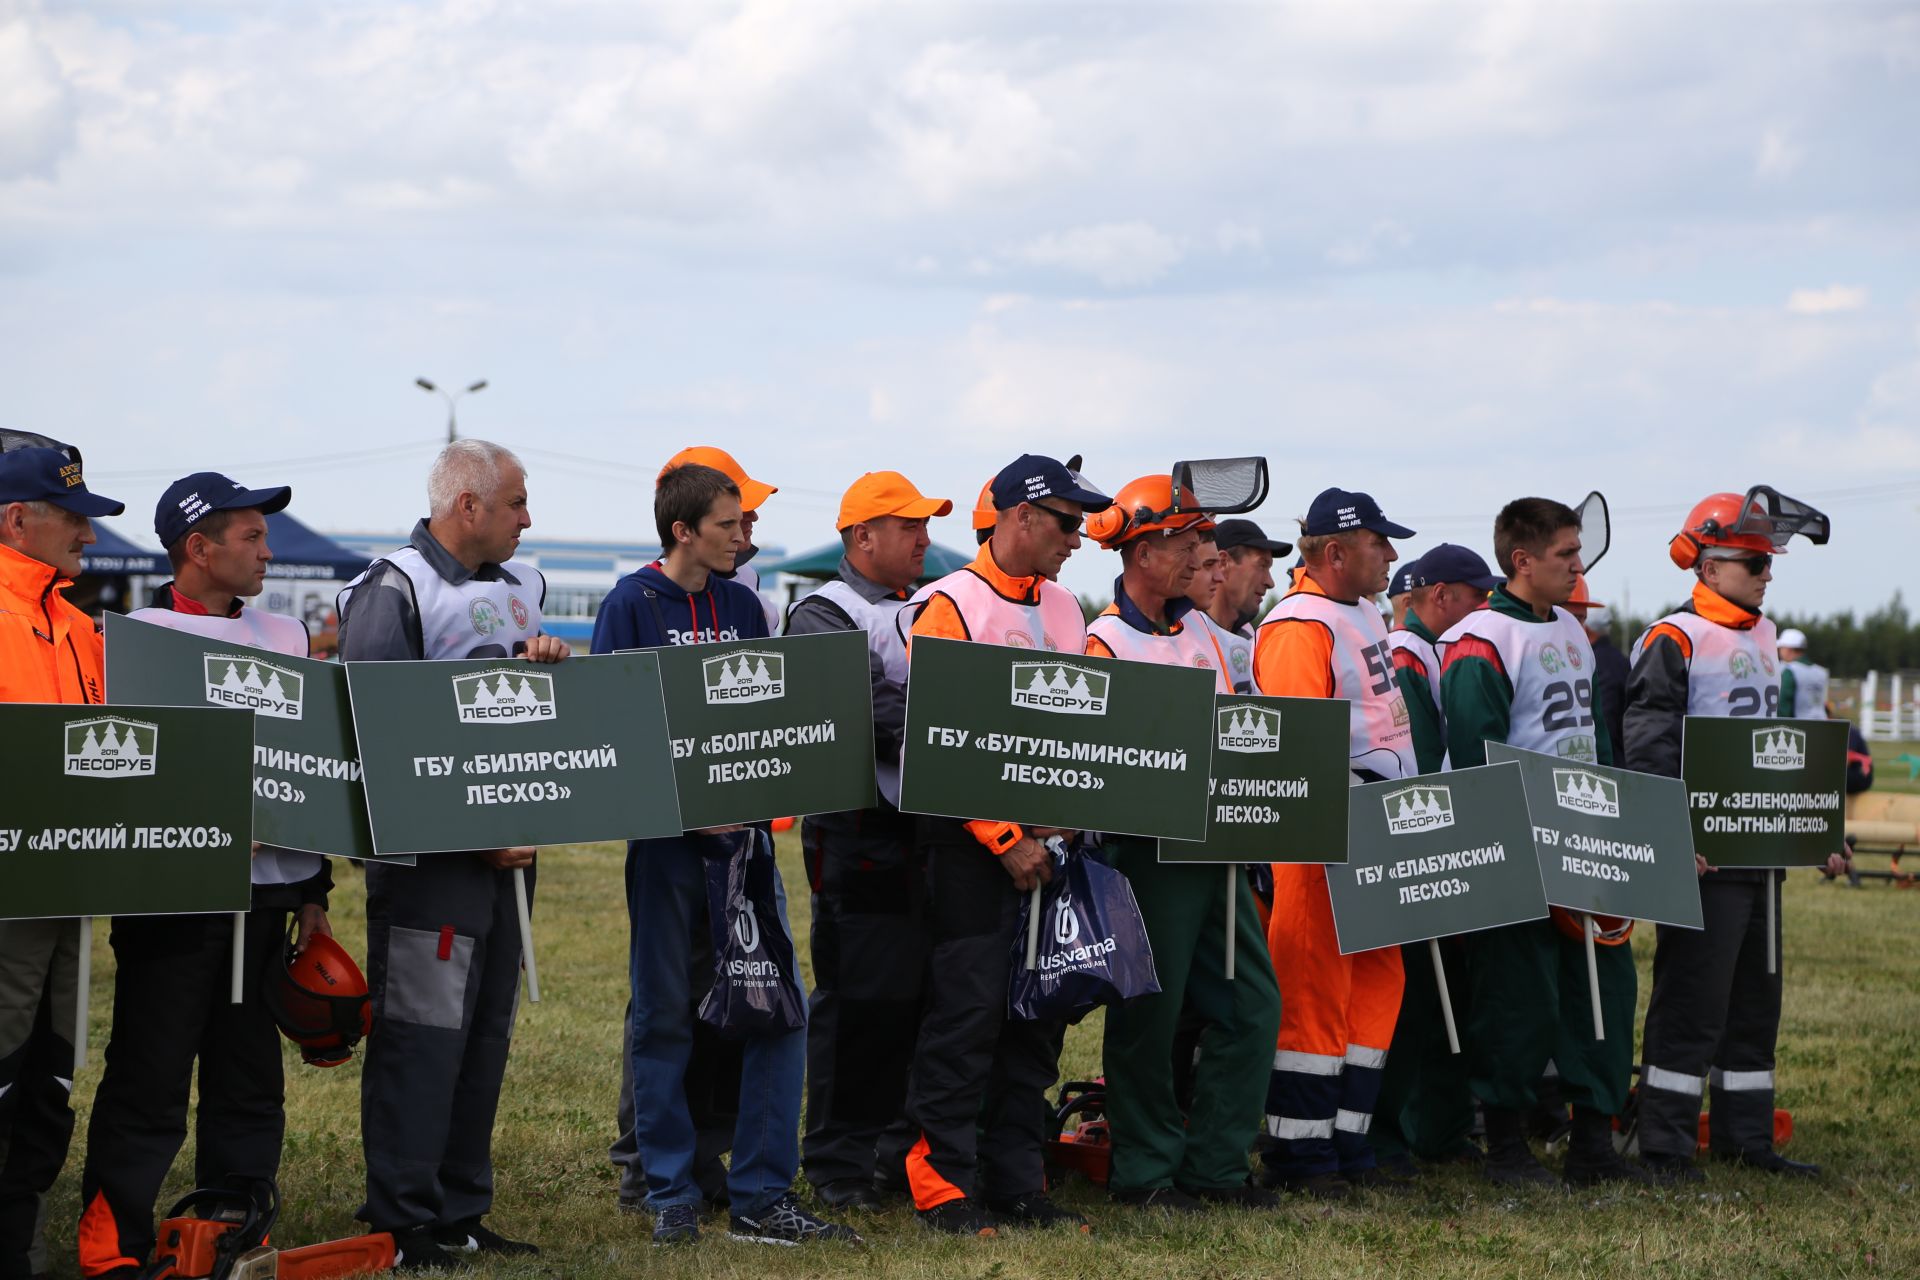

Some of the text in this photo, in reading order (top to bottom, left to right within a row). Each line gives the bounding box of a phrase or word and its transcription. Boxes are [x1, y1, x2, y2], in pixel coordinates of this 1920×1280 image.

[1025, 475, 1044, 485] READY
[1028, 483, 1045, 491] WHEN
[179, 492, 199, 508] READY
[1026, 488, 1052, 500] YOU ARE
[184, 500, 203, 514] WHEN
[186, 503, 212, 524] YOU ARE
[1337, 507, 1356, 515] READY
[1350, 519, 1361, 527] ARE
[244, 685, 263, 694] 2019
[710, 683, 781, 700] ЛЕСОРУБ
[1050, 687, 1069, 695] 2019
[210, 687, 298, 716] ЛЕСОРУБ
[463, 704, 552, 719] ЛЕСОРУБ
[1015, 692, 1103, 711] ЛЕСОРУБ
[1542, 678, 1594, 732] 29
[671, 719, 836, 758] БУ «БОЛГАРСКИЙ
[927, 726, 1187, 771] ГБУ «БУГУЛЬМИНСКИЙ
[1221, 736, 1277, 748] ЛЕСОРУБ
[68, 758, 152, 771] ЛЕСОРУБ
[254, 745, 365, 783] ЛИНСКИЙ
[413, 743, 617, 776] ГБУ «БИЛЯРСКИЙ
[1756, 755, 1804, 765] ЛЕСОРУБ
[708, 757, 792, 784] ЛЕСХОЗ»
[1001, 762, 1105, 790] ЛЕСХОЗ»
[254, 776, 306, 803] ХОЗ»
[466, 781, 572, 804] ЛЕСХОЗ»
[1220, 777, 1308, 798] «БУИНСКИЙ
[1559, 794, 1617, 814] ЛЕСОРУБ
[1690, 790, 1839, 812] ГБУ «ЗЕЛЕНОДОЛЬСКИЙ
[1215, 805, 1280, 823] ЛЕСХОЗ»
[1391, 813, 1452, 831] ЛЕСОРУБ
[1703, 813, 1828, 833] ОПЫТНЫЙ ЛЕСХОЗ»
[0, 822, 233, 851] БУ «АРСКИЙ ЛЕСХОЗ»
[1532, 825, 1655, 864] ГБУ «ЗАИНСКИЙ
[1355, 841, 1506, 886] ГБУ «ЕЛАБУЖСКИЙ
[1562, 855, 1630, 883] ЛЕСХОЗ»
[1399, 878, 1470, 905] ЛЕСХОЗ»
[1041, 971, 1060, 980] READY
[1078, 962, 1093, 970] YOU
[1094, 959, 1107, 967] ARE
